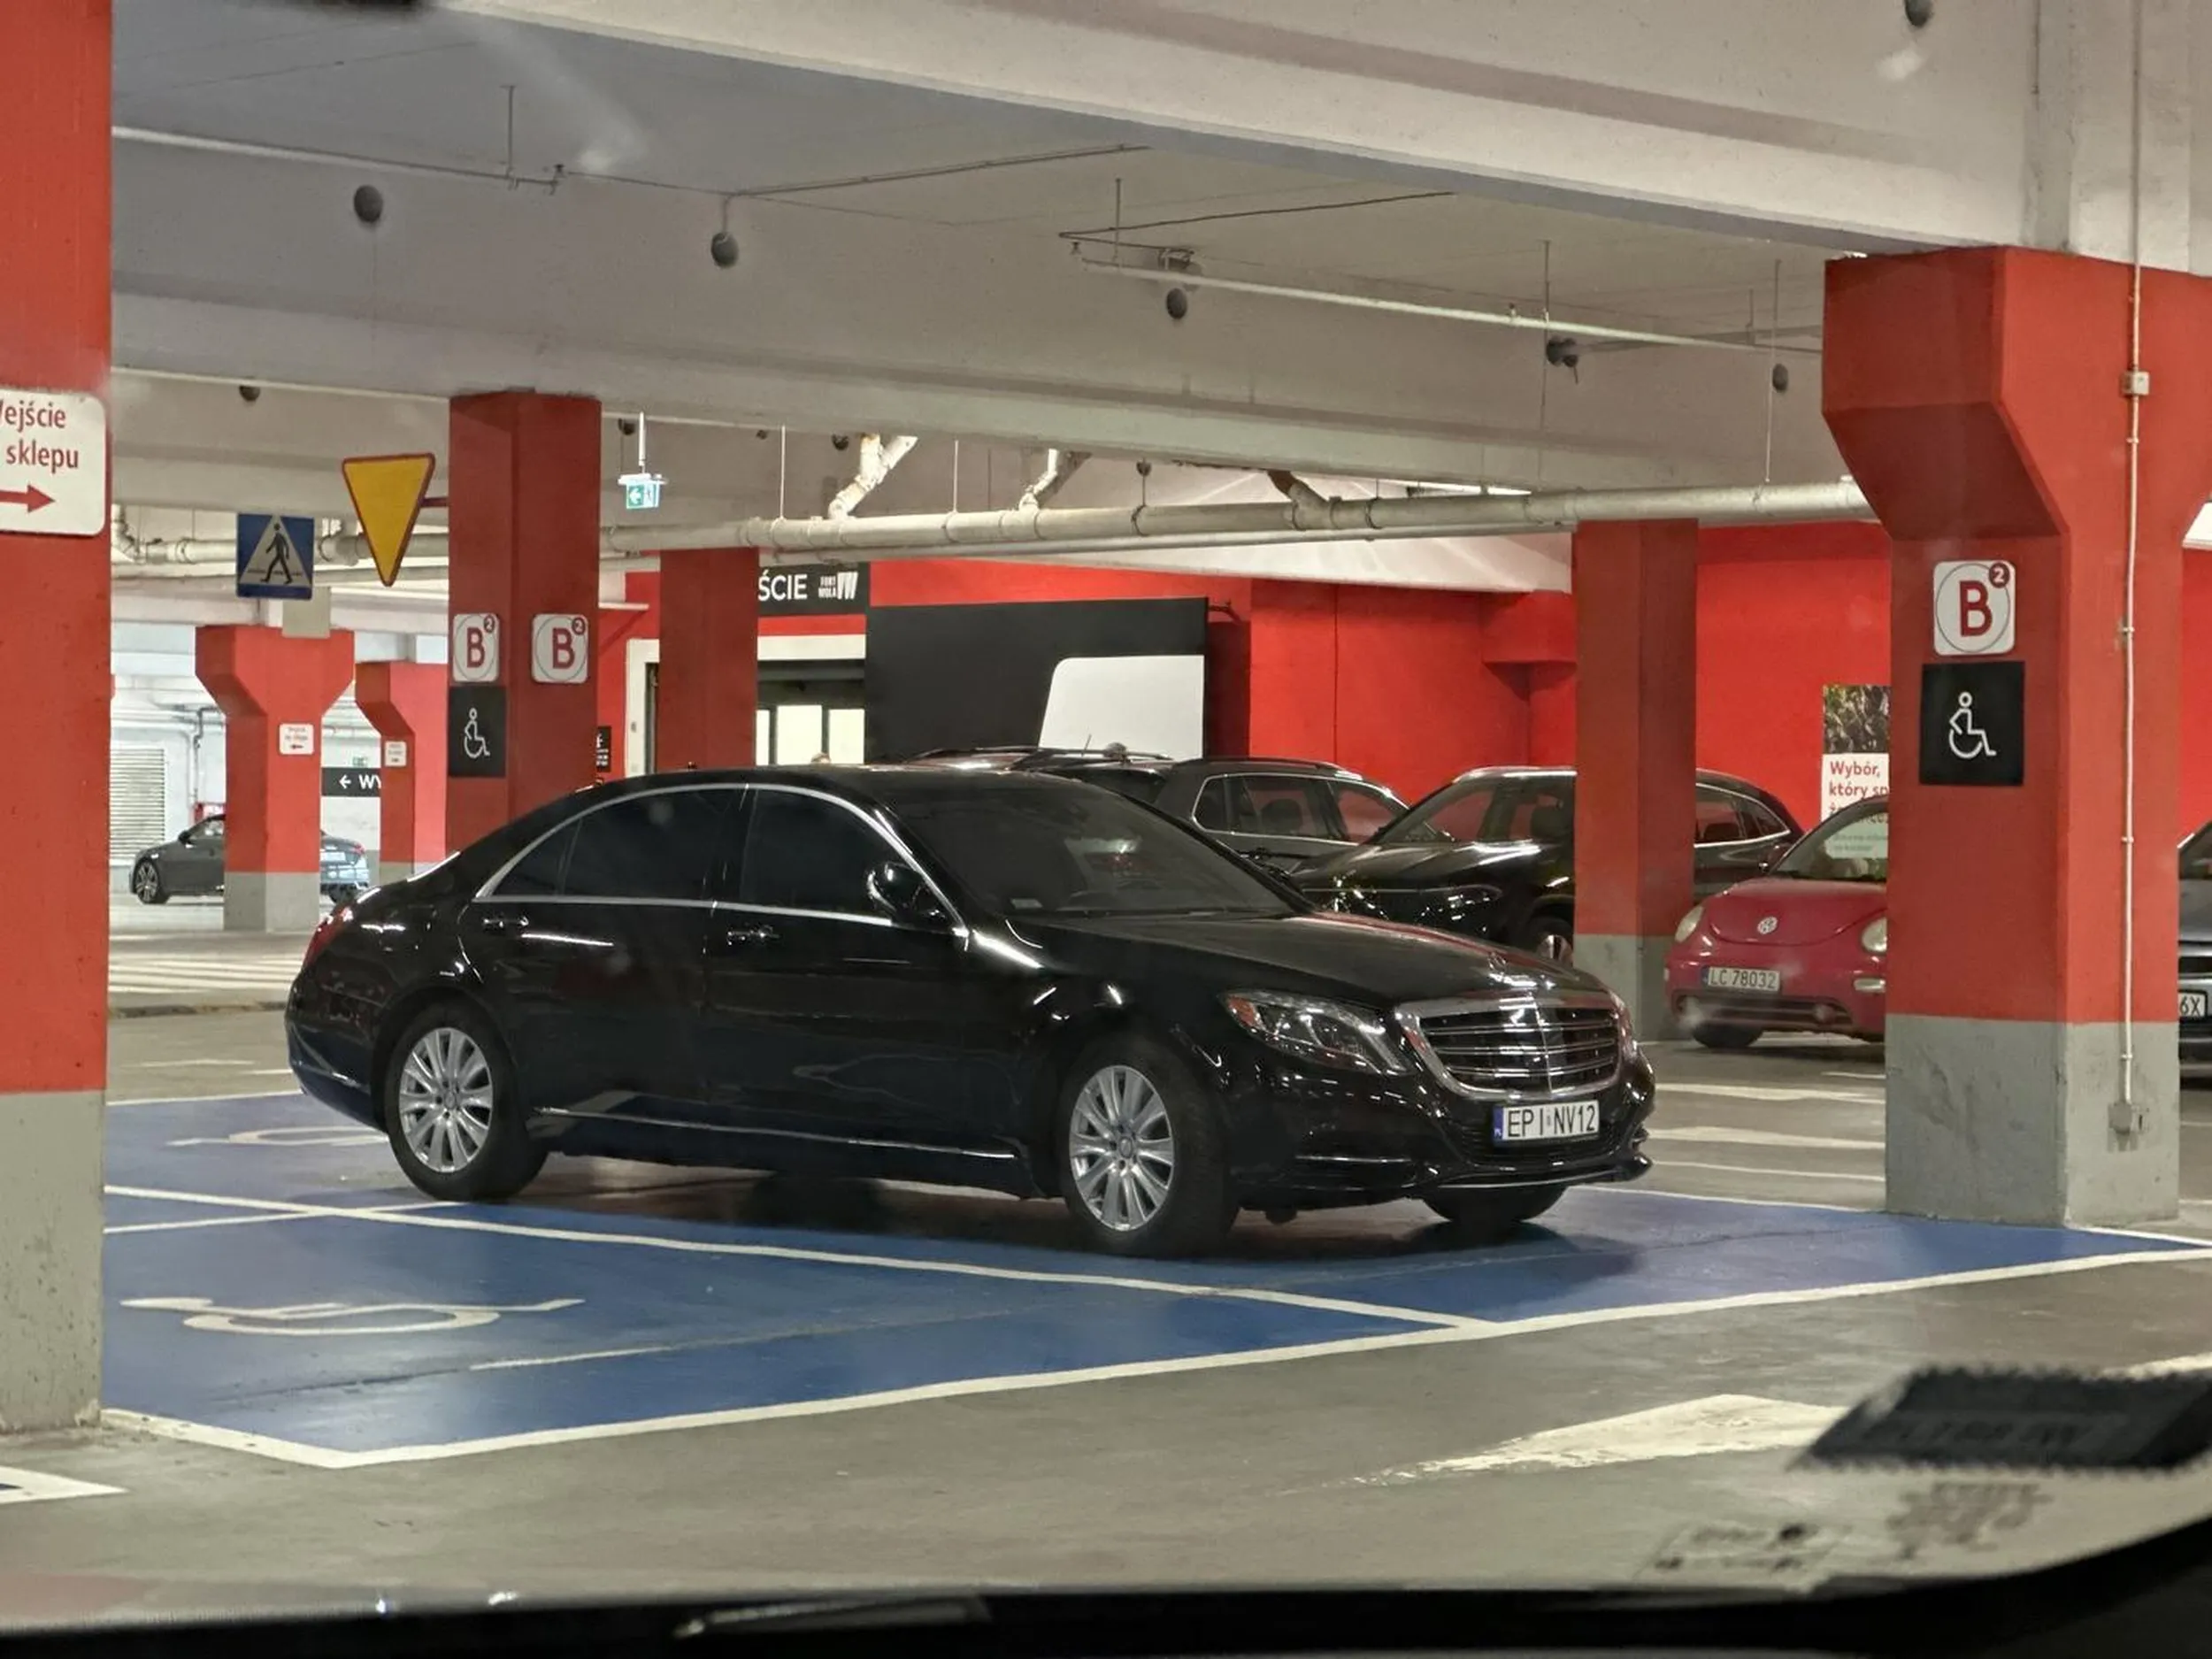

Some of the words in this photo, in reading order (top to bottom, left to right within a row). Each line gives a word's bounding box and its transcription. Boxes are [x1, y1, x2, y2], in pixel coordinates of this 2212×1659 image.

[0, 399, 65, 433] ejście
[6, 439, 79, 474] sklepu
[1960, 580, 1993, 637] B
[467, 627, 485, 668] B
[552, 627, 575, 669] B
[1829, 761, 1881, 779] Wybór,
[1829, 780, 1869, 800] który
[1711, 969, 1728, 986] LC
[1732, 970, 1778, 989] 78032
[2179, 995, 2201, 1017] 6X
[1554, 1103, 1596, 1135] NV12
